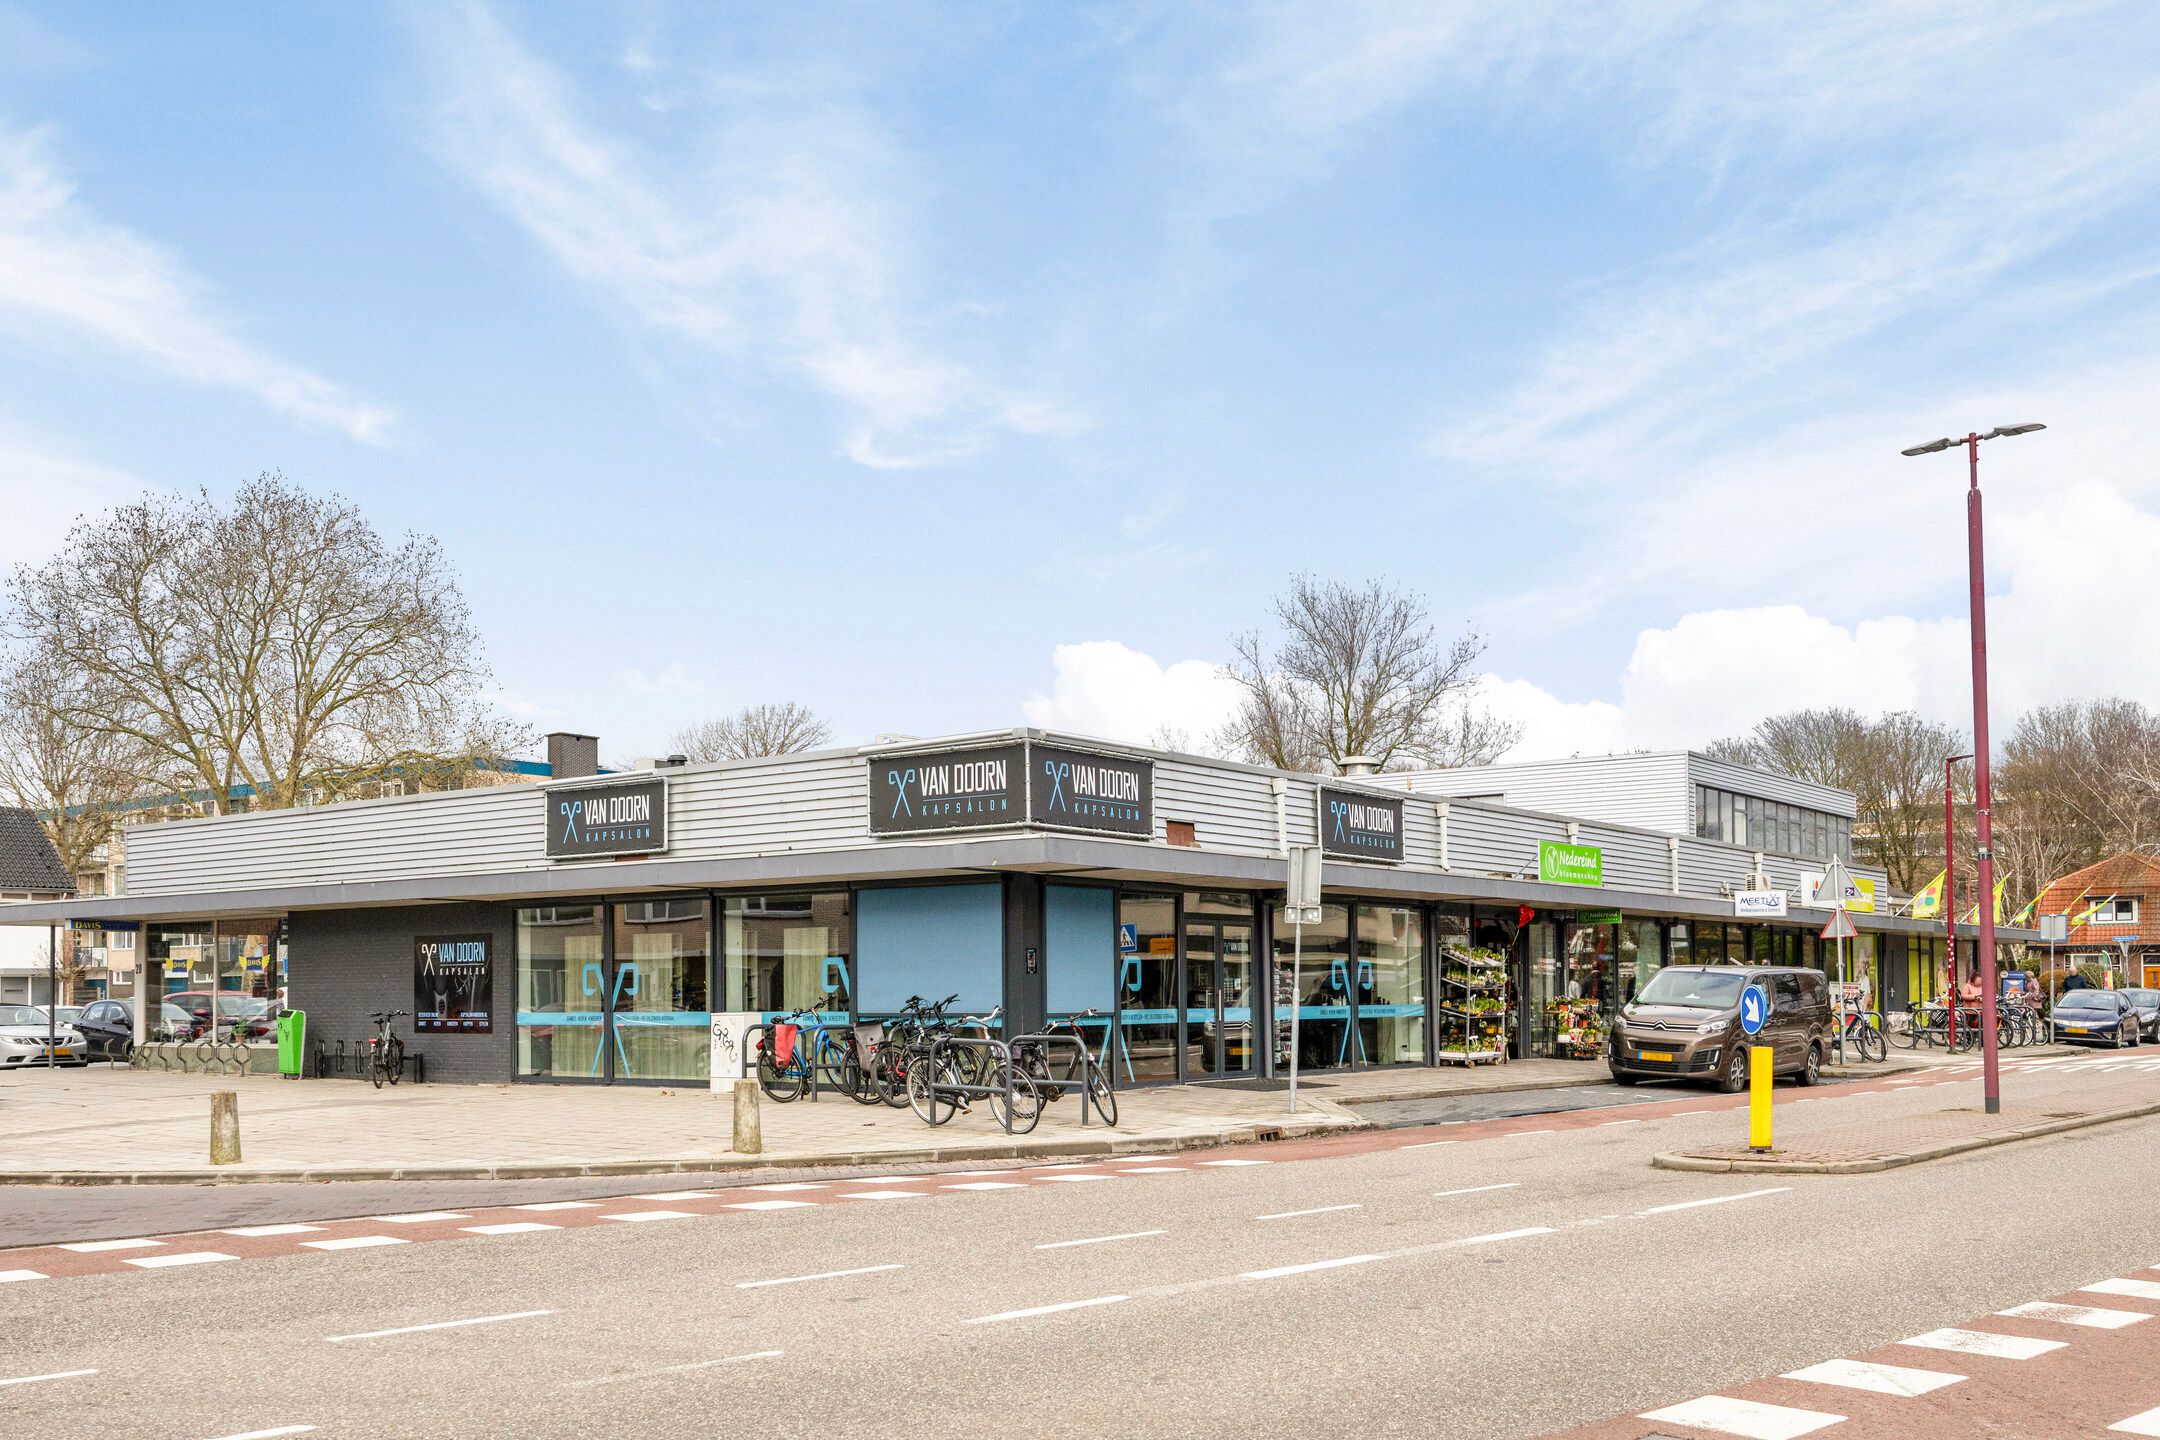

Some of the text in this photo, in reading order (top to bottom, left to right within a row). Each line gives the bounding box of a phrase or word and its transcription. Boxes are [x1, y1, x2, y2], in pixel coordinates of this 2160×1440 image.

[920, 760, 1007, 796] VAN DOORN
[1072, 764, 1139, 801] VAN DOORN
[584, 795, 650, 825] VAN DOORN
[922, 799, 1007, 816] KAPSALON
[1074, 802, 1140, 821] KAPSALON
[1348, 803, 1394, 833] VAN DOORN
[585, 829, 650, 843] KAPSALON
[1350, 835, 1395, 849] KAPSALON
[1559, 849, 1597, 869] Nedereind
[1560, 871, 1598, 881] bloemenshop
[1740, 895, 1781, 907] MEETLAT
[438, 942, 485, 962] VAN DOORN
[440, 967, 485, 976] KAPSALON
